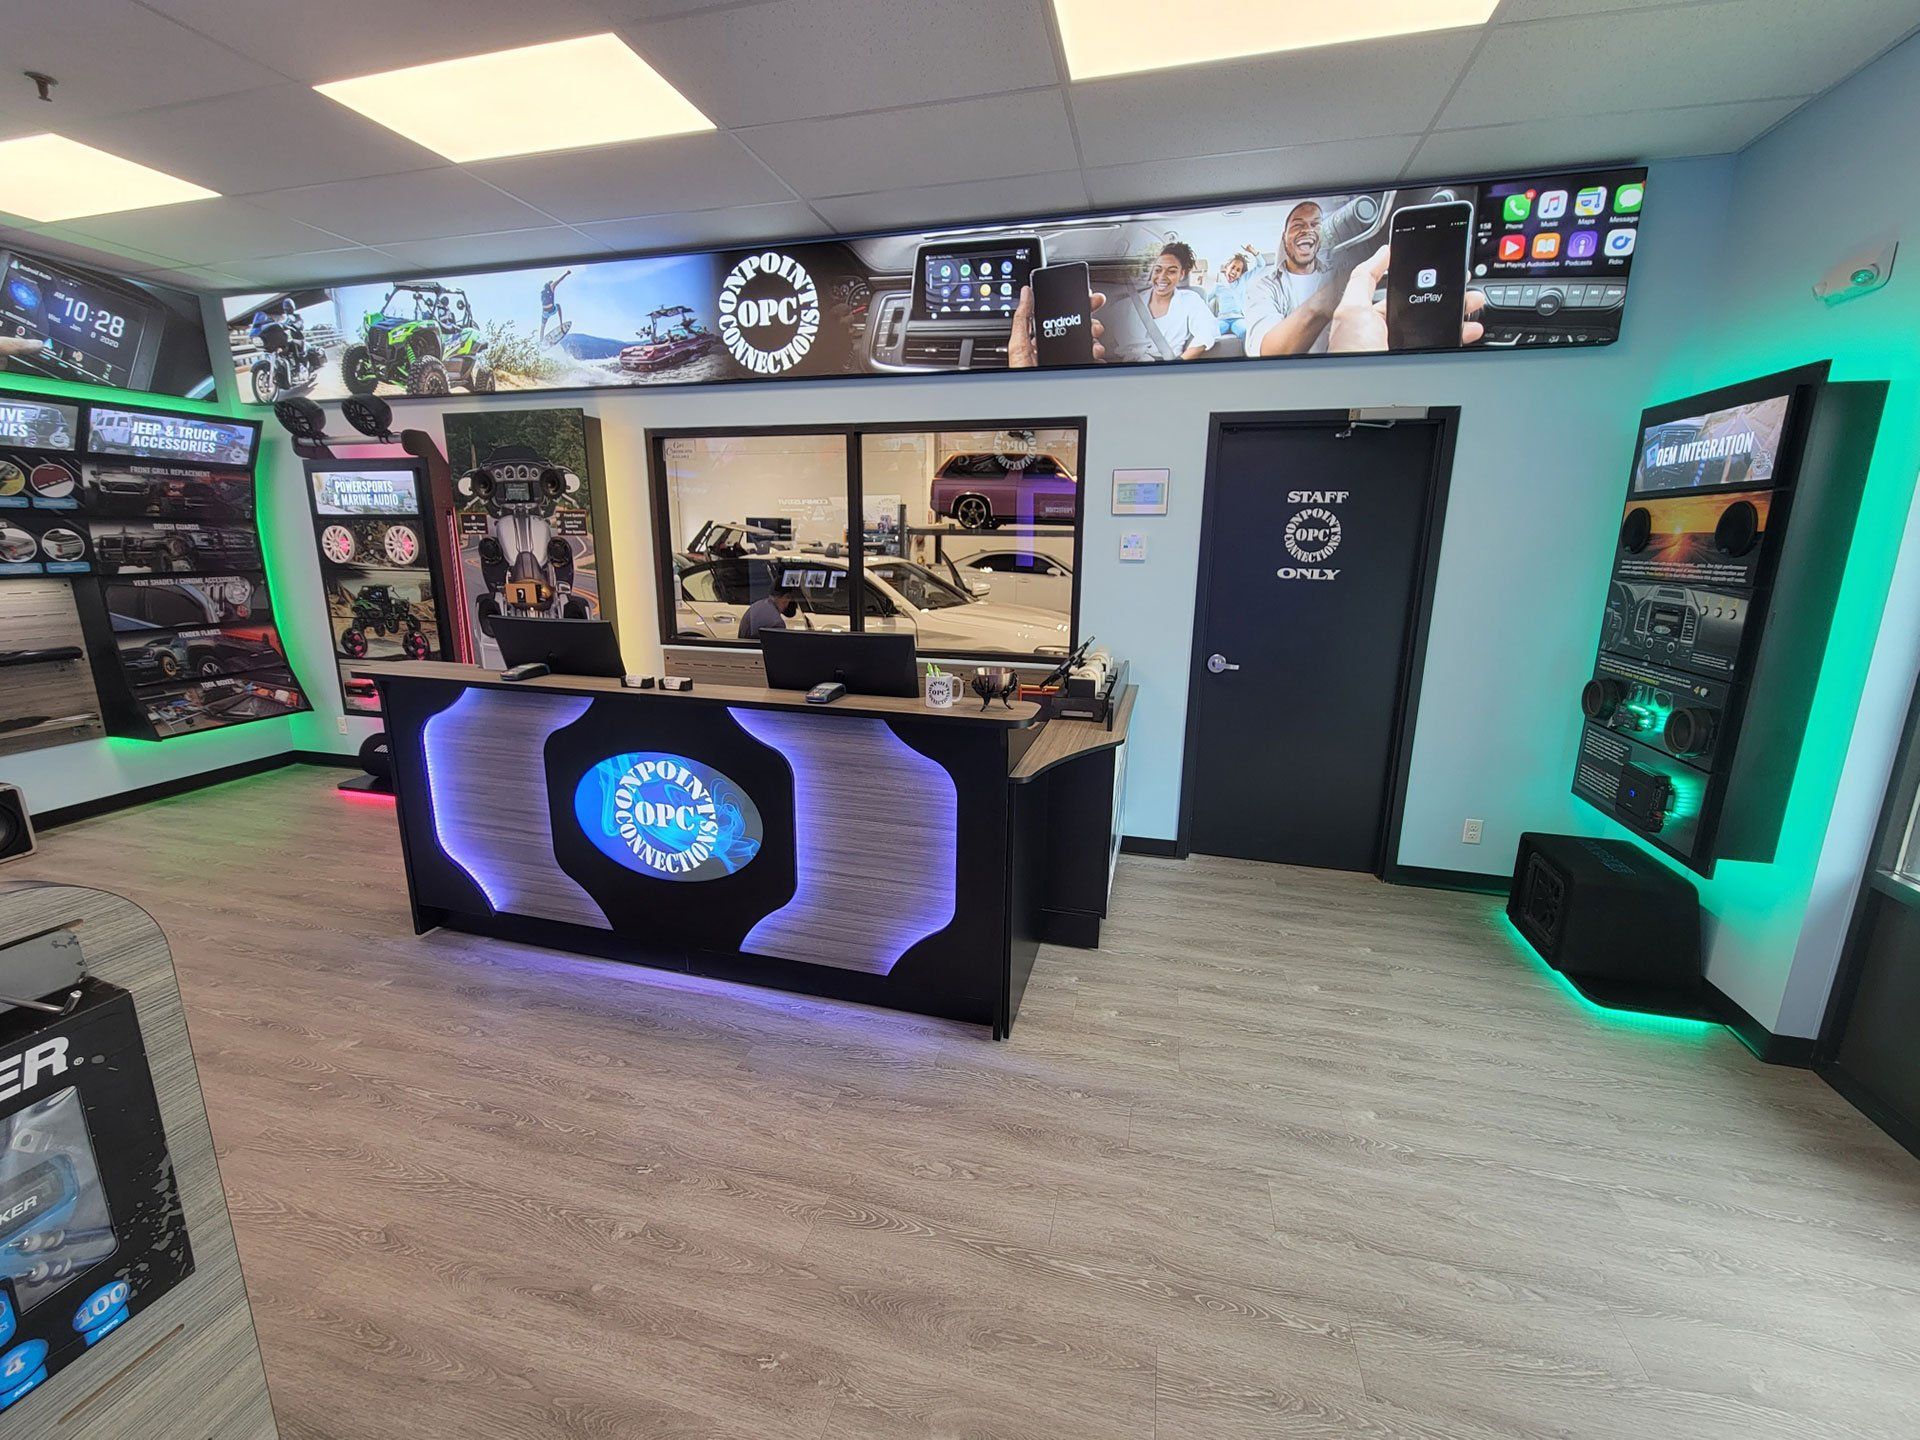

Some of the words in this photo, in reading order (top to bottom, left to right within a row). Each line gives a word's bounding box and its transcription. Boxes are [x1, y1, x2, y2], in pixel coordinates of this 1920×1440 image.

[1409, 293, 1443, 304] CarPlay
[64, 297, 125, 338] 10:28
[738, 297, 797, 327] OPC
[1043, 314, 1081, 329] android
[719, 309, 820, 373] CONNECTIONS
[1044, 327, 1066, 337] auto
[100, 336, 119, 348] 2020
[131, 421, 161, 435] JEEP
[165, 425, 174, 437] &
[178, 427, 218, 441] TRUCK
[130, 435, 216, 453] ACCESSORIES
[1656, 445, 1678, 467] OEM
[1678, 432, 1755, 463] INTEGRATION
[130, 465, 151, 473] FRONT
[171, 469, 210, 477] REPLACEMENT
[334, 480, 394, 493] POWERSPORTS
[333, 494, 340, 506] &
[341, 494, 372, 506] MARINE
[374, 494, 399, 505] AUDIO
[1287, 490, 1350, 504] STAFF
[1295, 527, 1330, 541] OPC
[1284, 533, 1342, 563] CONNECTIONS
[1276, 567, 1341, 580] ONLY
[634, 801, 695, 831] OPC
[614, 810, 719, 874] CONNECTIONS
[75, 1282, 128, 1329] 100
[5, 1348, 29, 1377] 4
